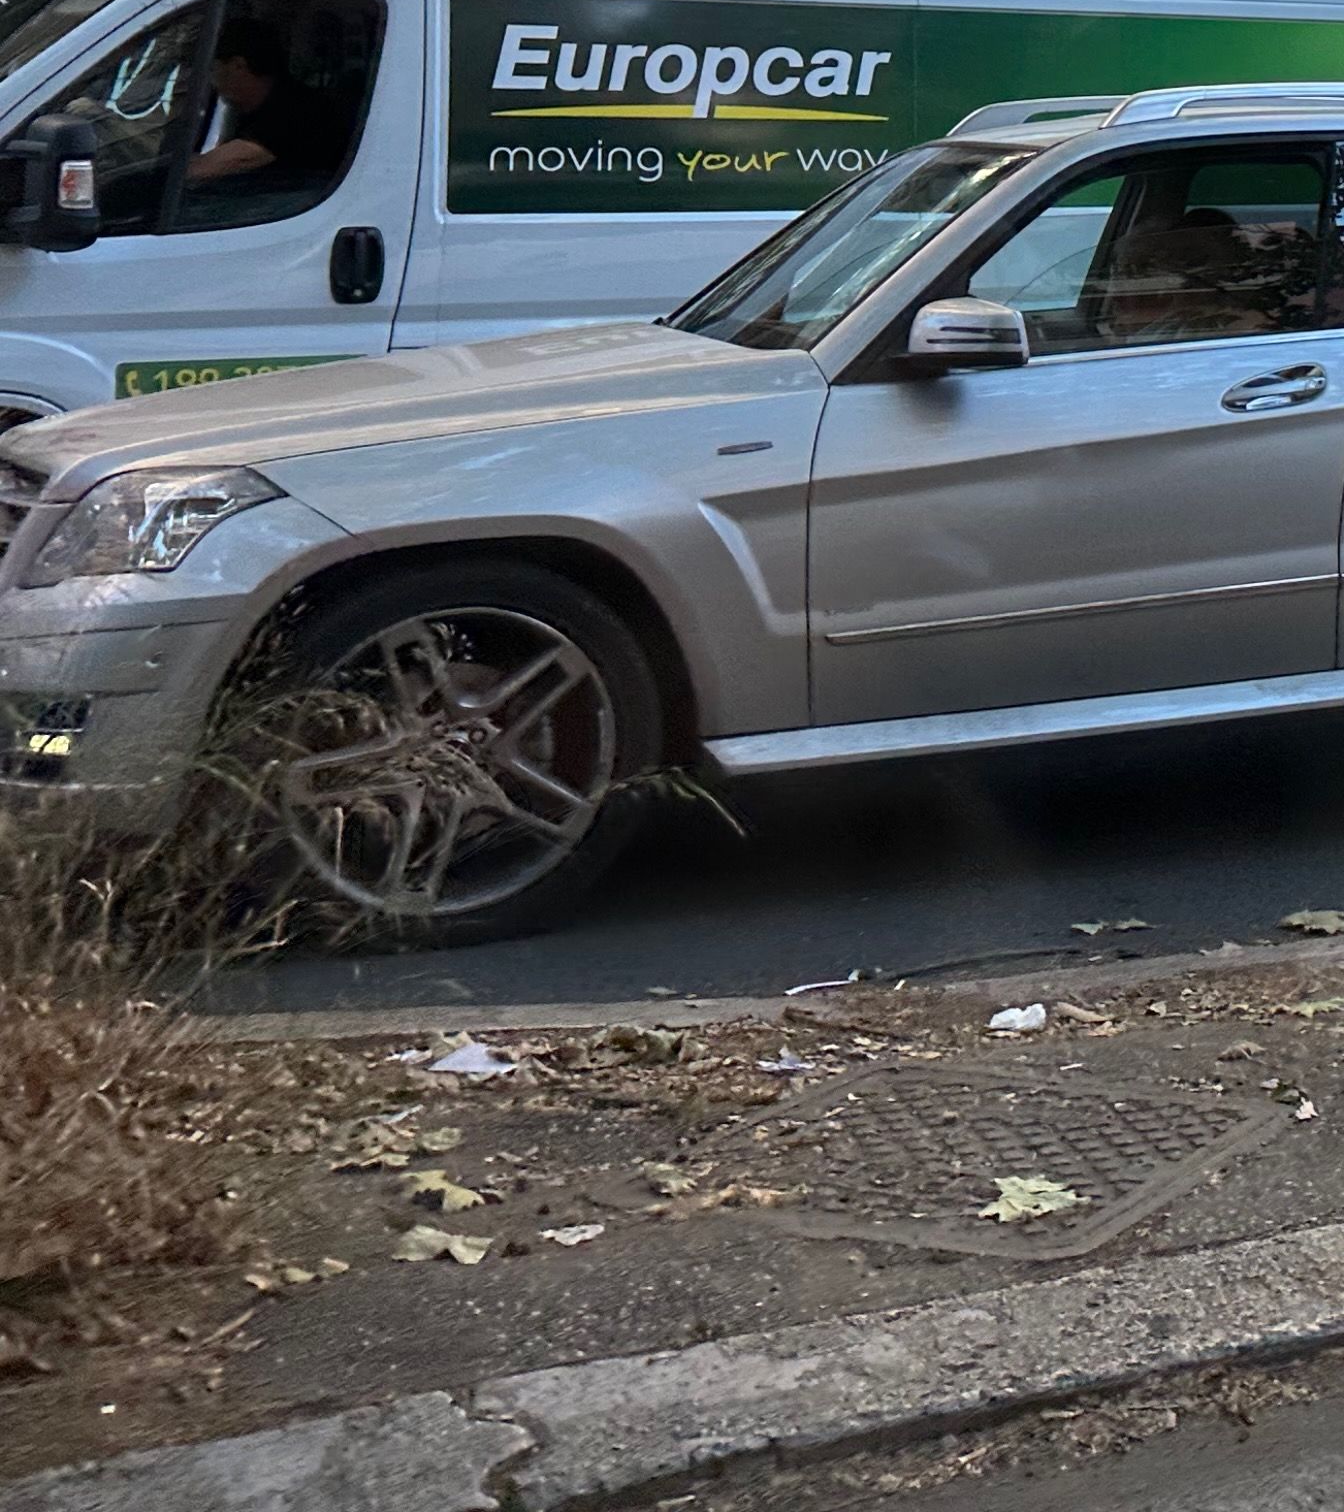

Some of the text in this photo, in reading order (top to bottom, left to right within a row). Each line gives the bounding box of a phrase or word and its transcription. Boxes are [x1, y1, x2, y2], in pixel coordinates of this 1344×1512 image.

[492, 24, 891, 118] Europcar
[489, 140, 663, 182] moving
[678, 149, 790, 181] your
